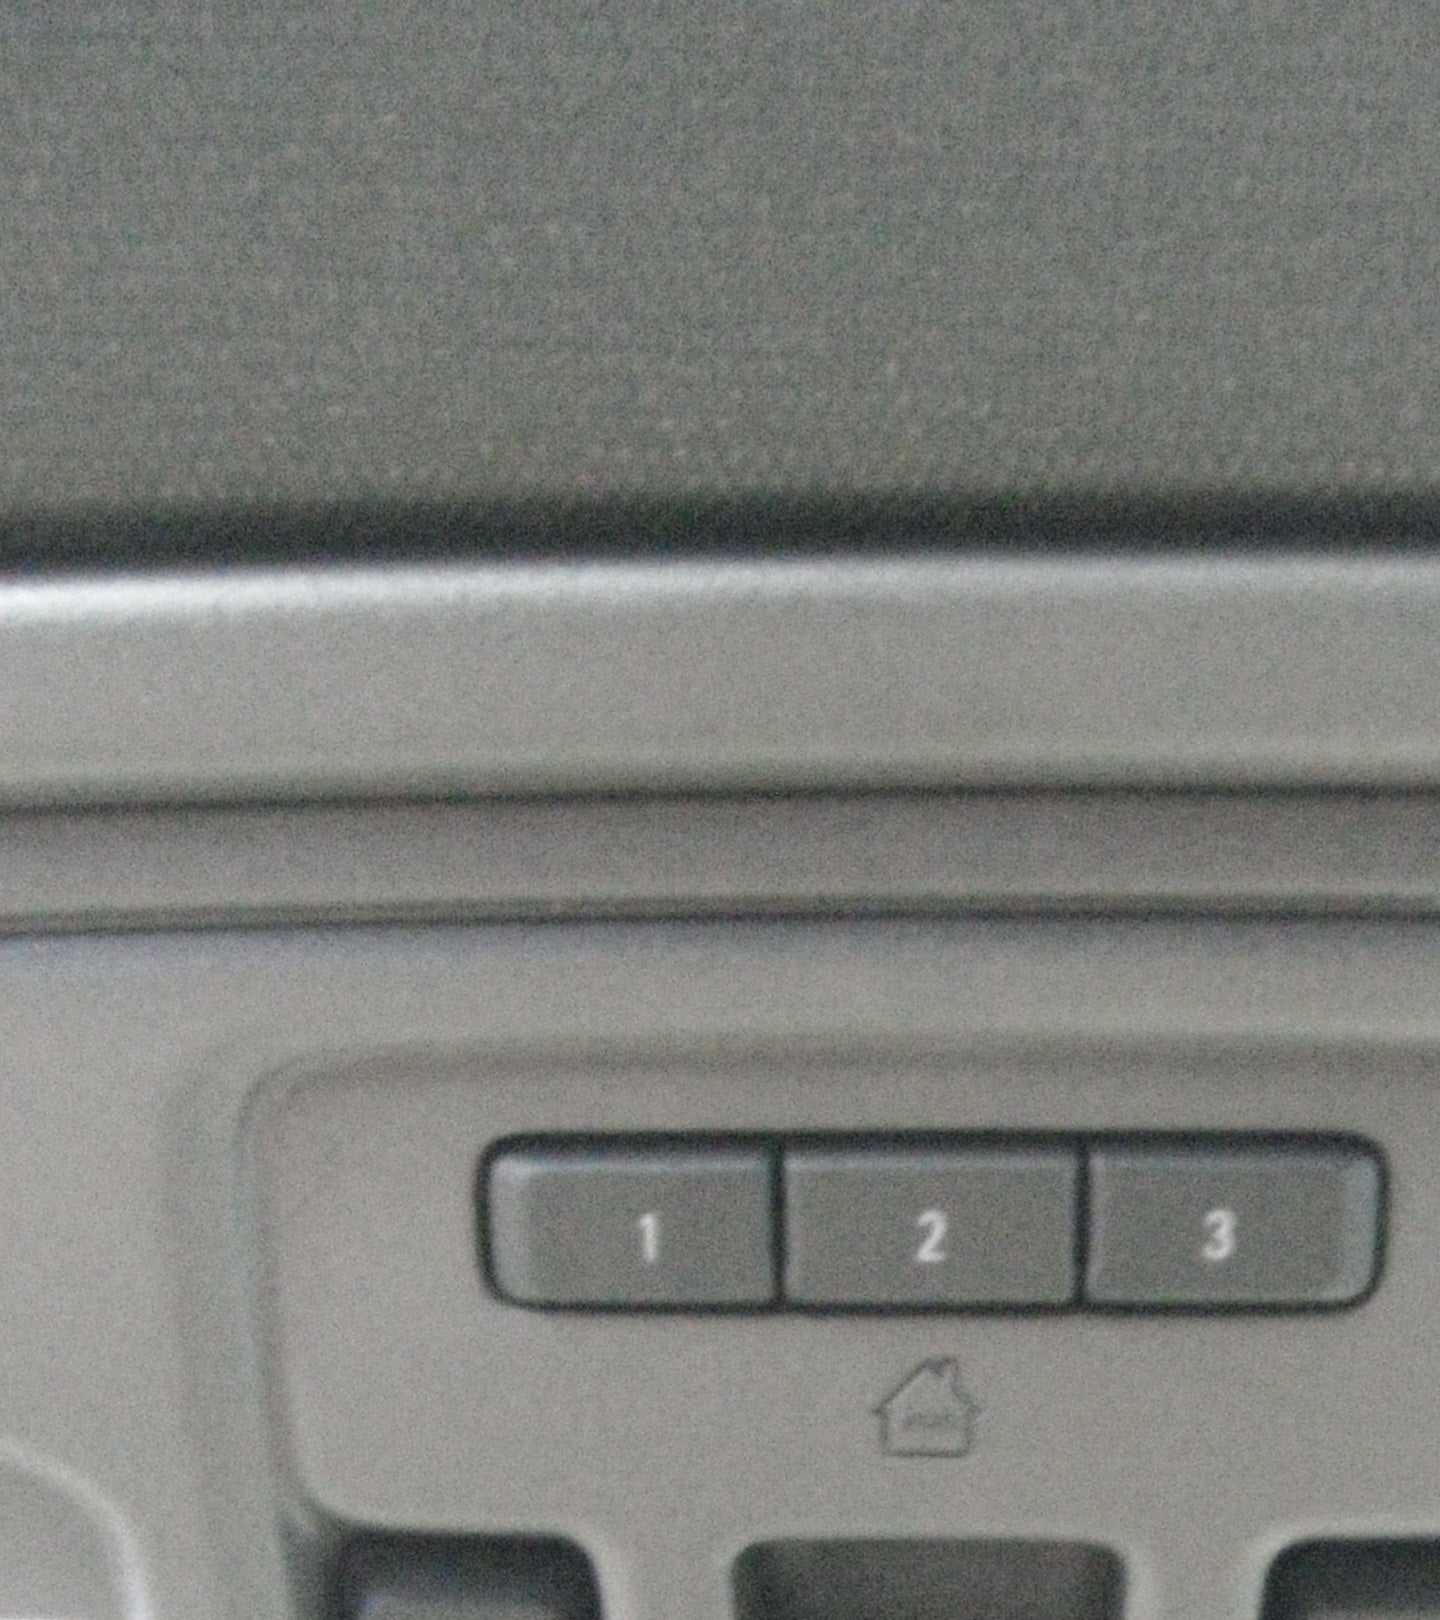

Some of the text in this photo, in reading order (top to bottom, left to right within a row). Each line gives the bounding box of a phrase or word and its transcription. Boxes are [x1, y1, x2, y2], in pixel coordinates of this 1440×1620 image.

[637, 1212, 659, 1262] 1
[915, 1209, 948, 1263] 2
[1202, 1208, 1236, 1262] 3
